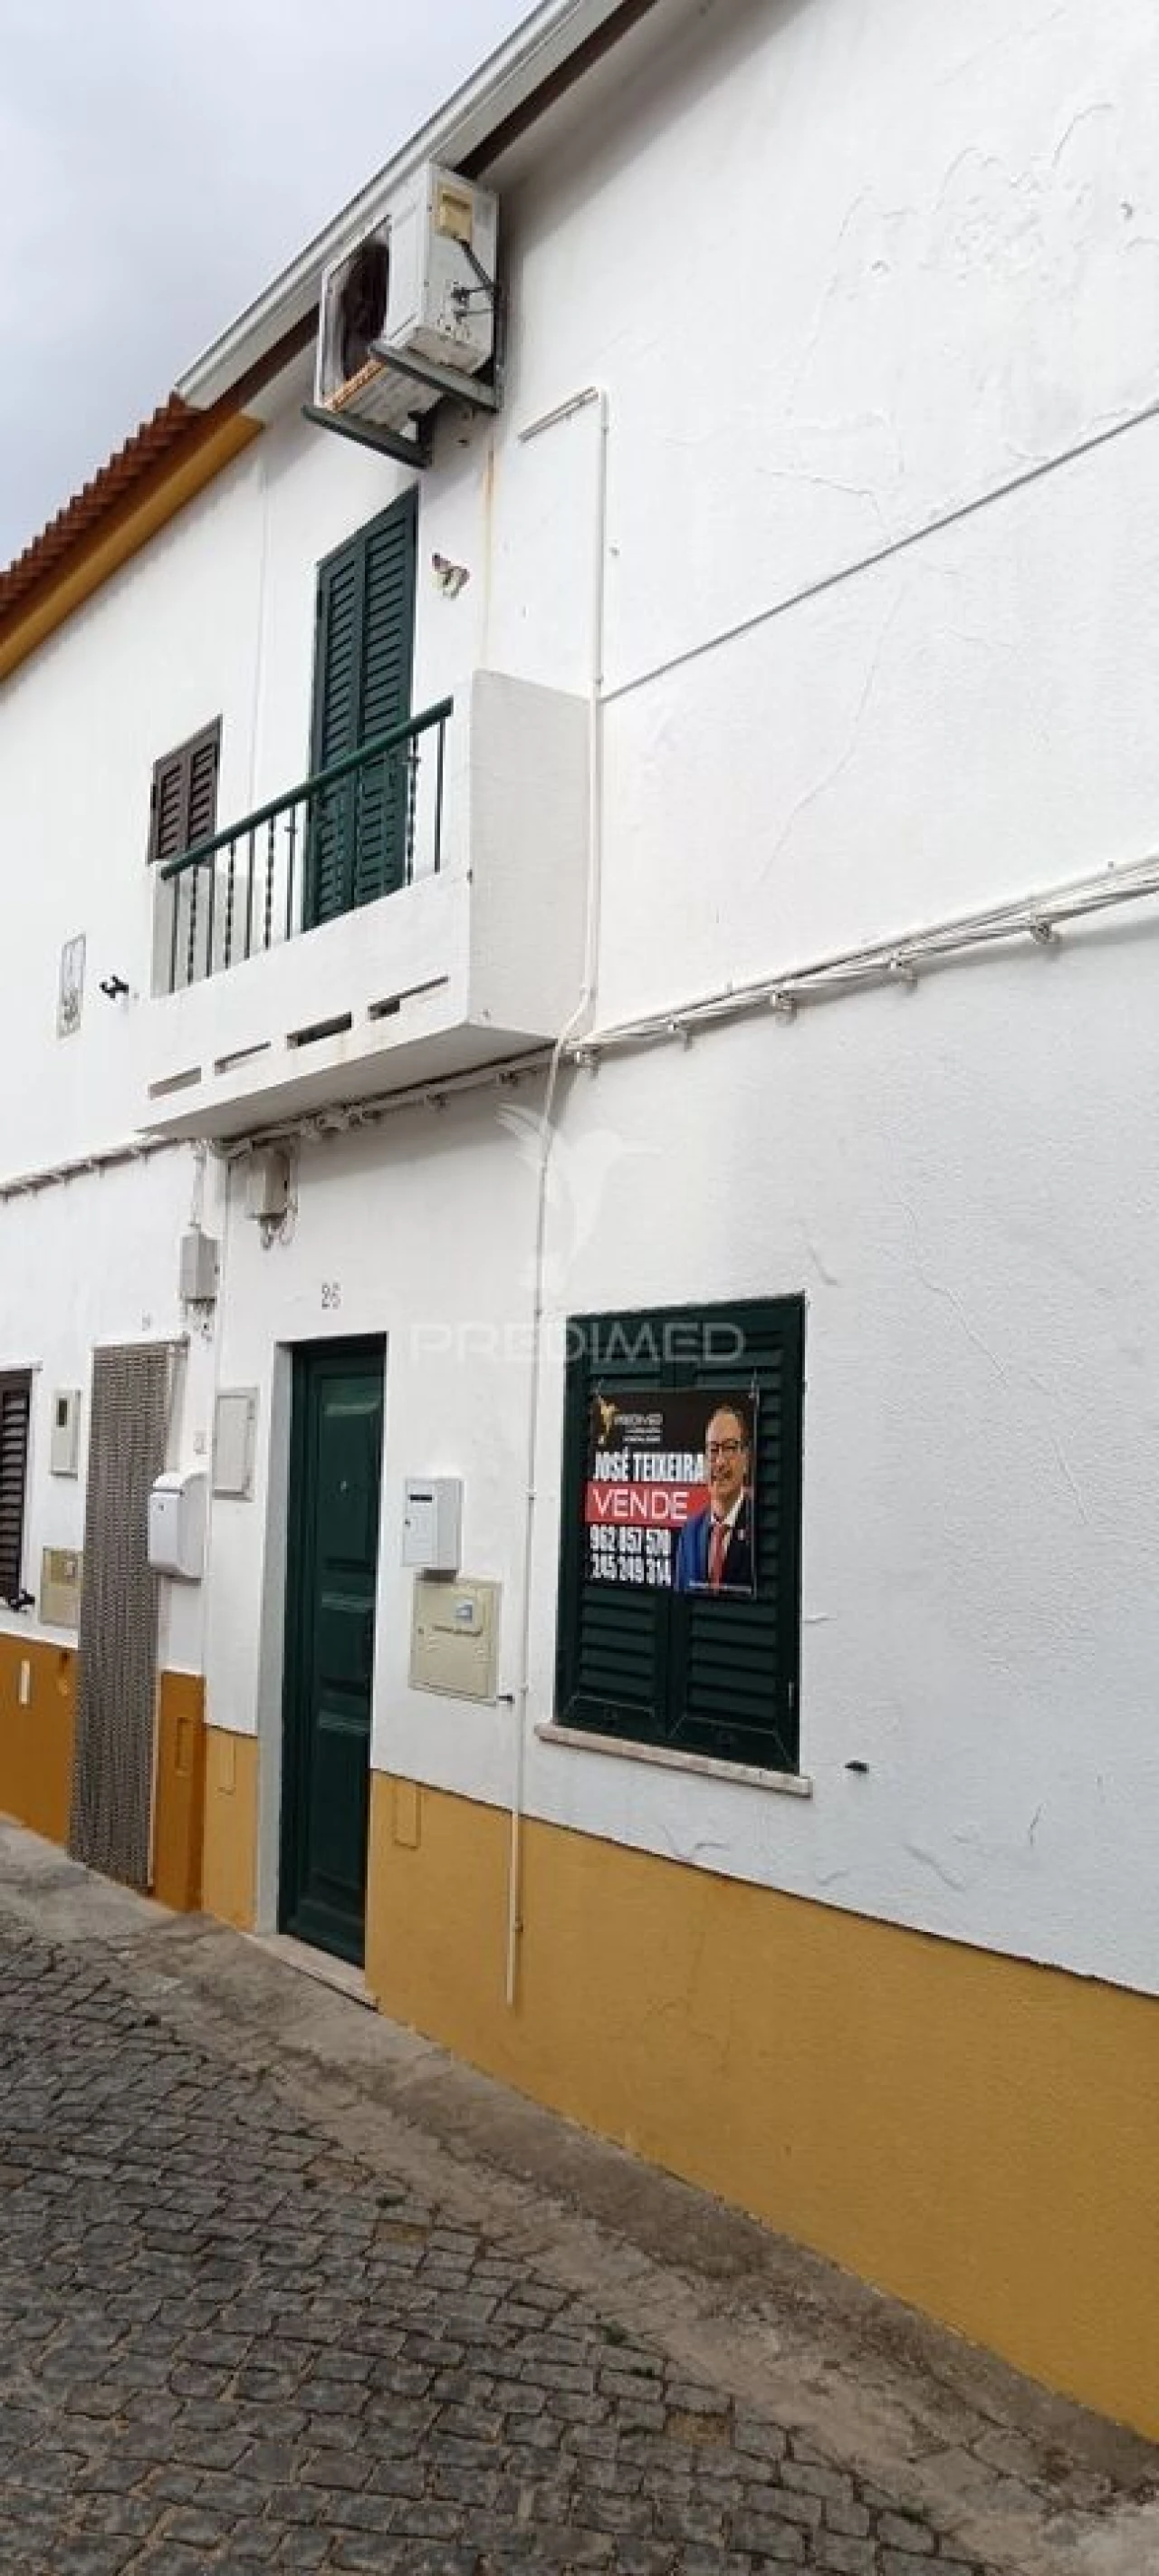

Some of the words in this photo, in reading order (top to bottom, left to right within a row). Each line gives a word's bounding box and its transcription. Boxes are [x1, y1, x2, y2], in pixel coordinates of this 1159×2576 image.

[321, 1283, 341, 1310] 26
[593, 1447, 628, 1481] JOSÉ
[633, 1453, 704, 1482] TEIXEIRA
[593, 1488, 689, 1520] VENDE
[590, 1525, 616, 1552] 962
[591, 1553, 618, 1581] 245
[646, 1557, 672, 1586] 314
